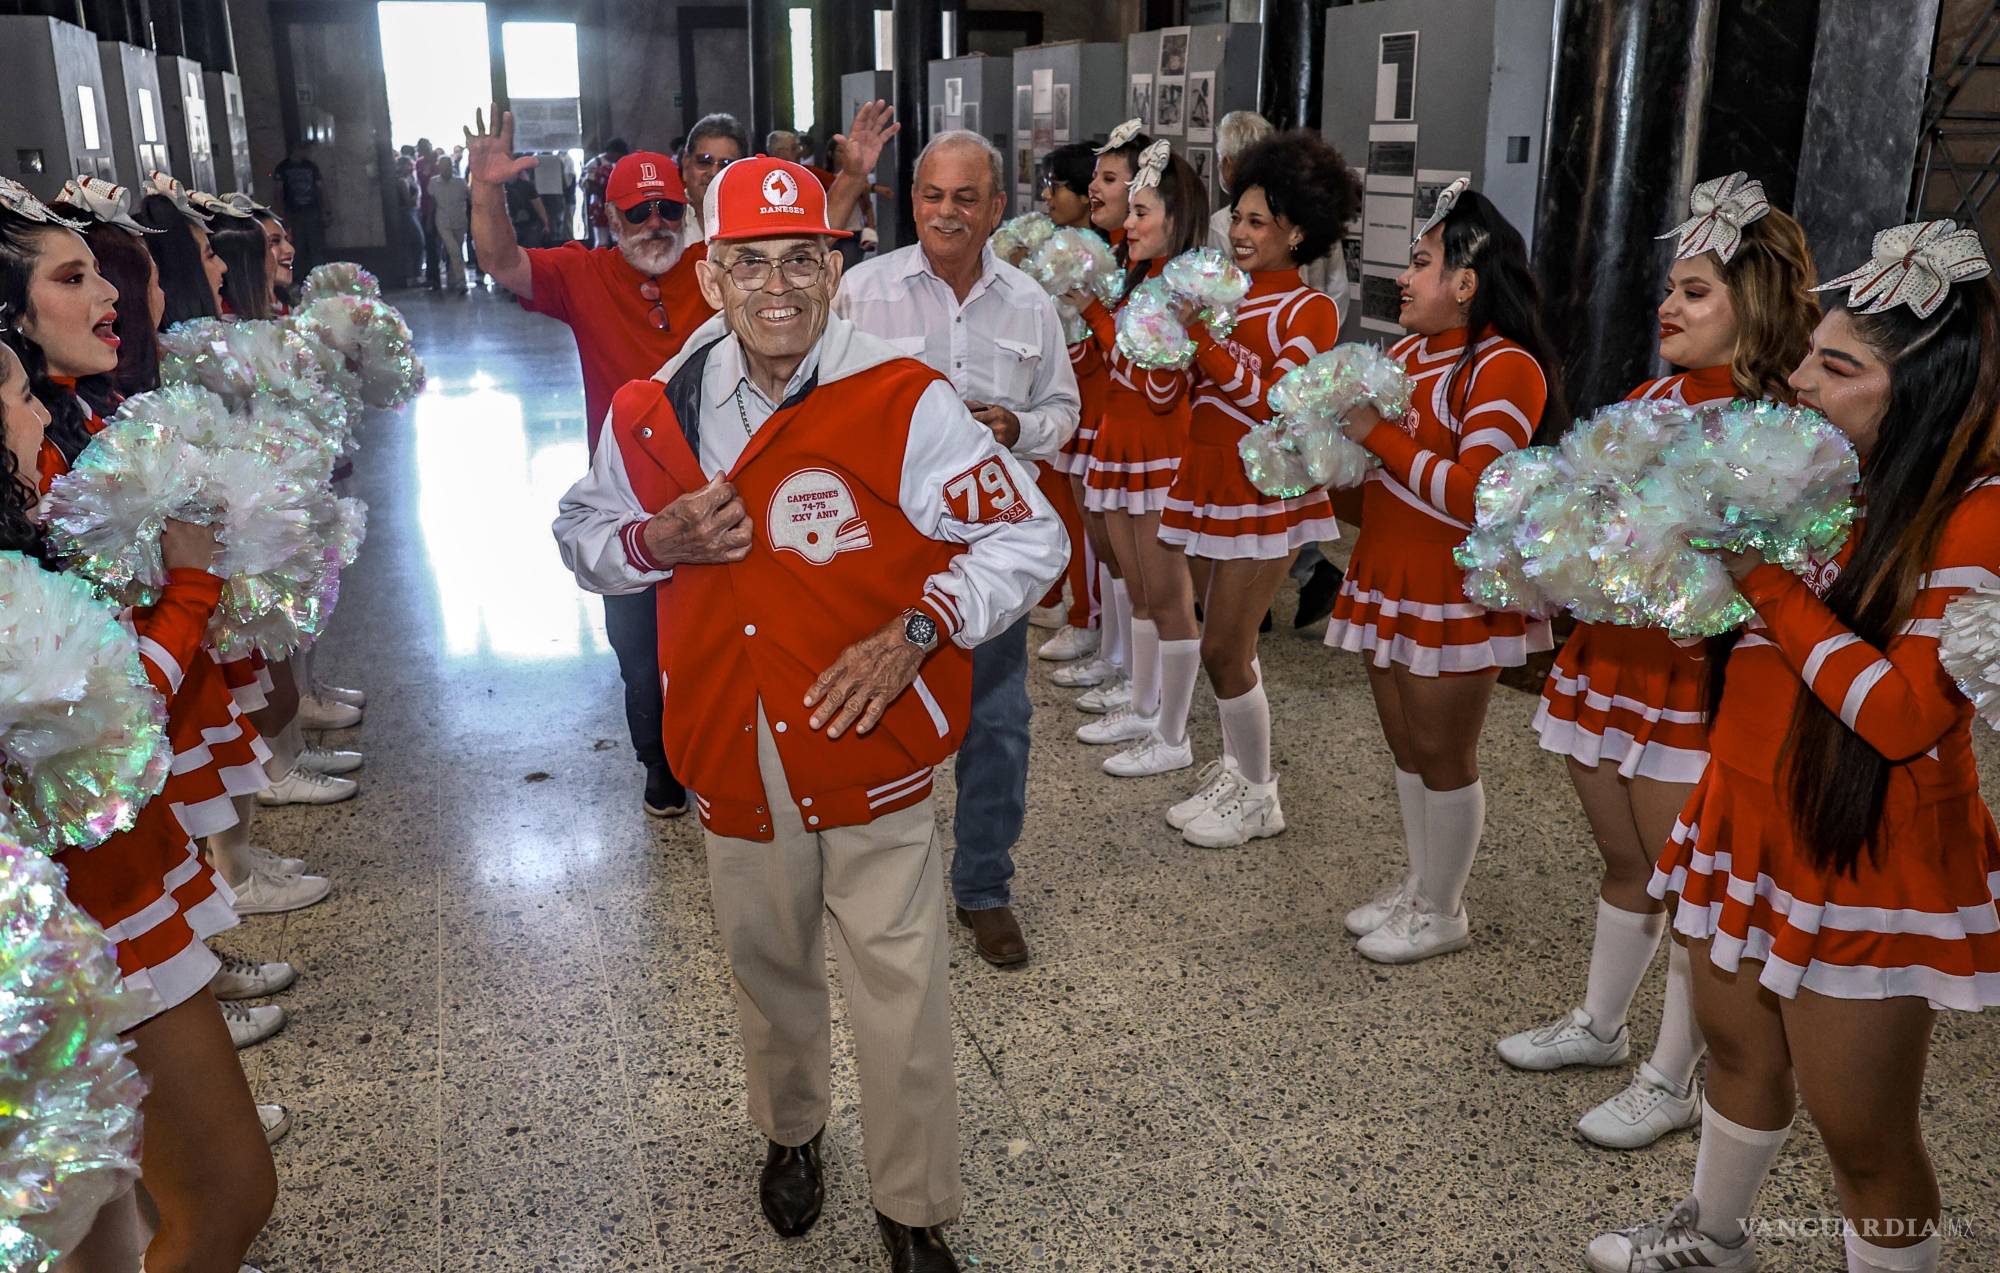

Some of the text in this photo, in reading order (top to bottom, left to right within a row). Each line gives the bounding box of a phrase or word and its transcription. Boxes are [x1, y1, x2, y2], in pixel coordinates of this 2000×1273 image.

[640, 162, 657, 181] D
[760, 206, 805, 215] DANESES
[787, 490, 839, 503] CAMPEONES
[946, 461, 1015, 522] 79
[802, 501, 826, 511] 74-75
[791, 509, 839, 522] XXV ANIV
